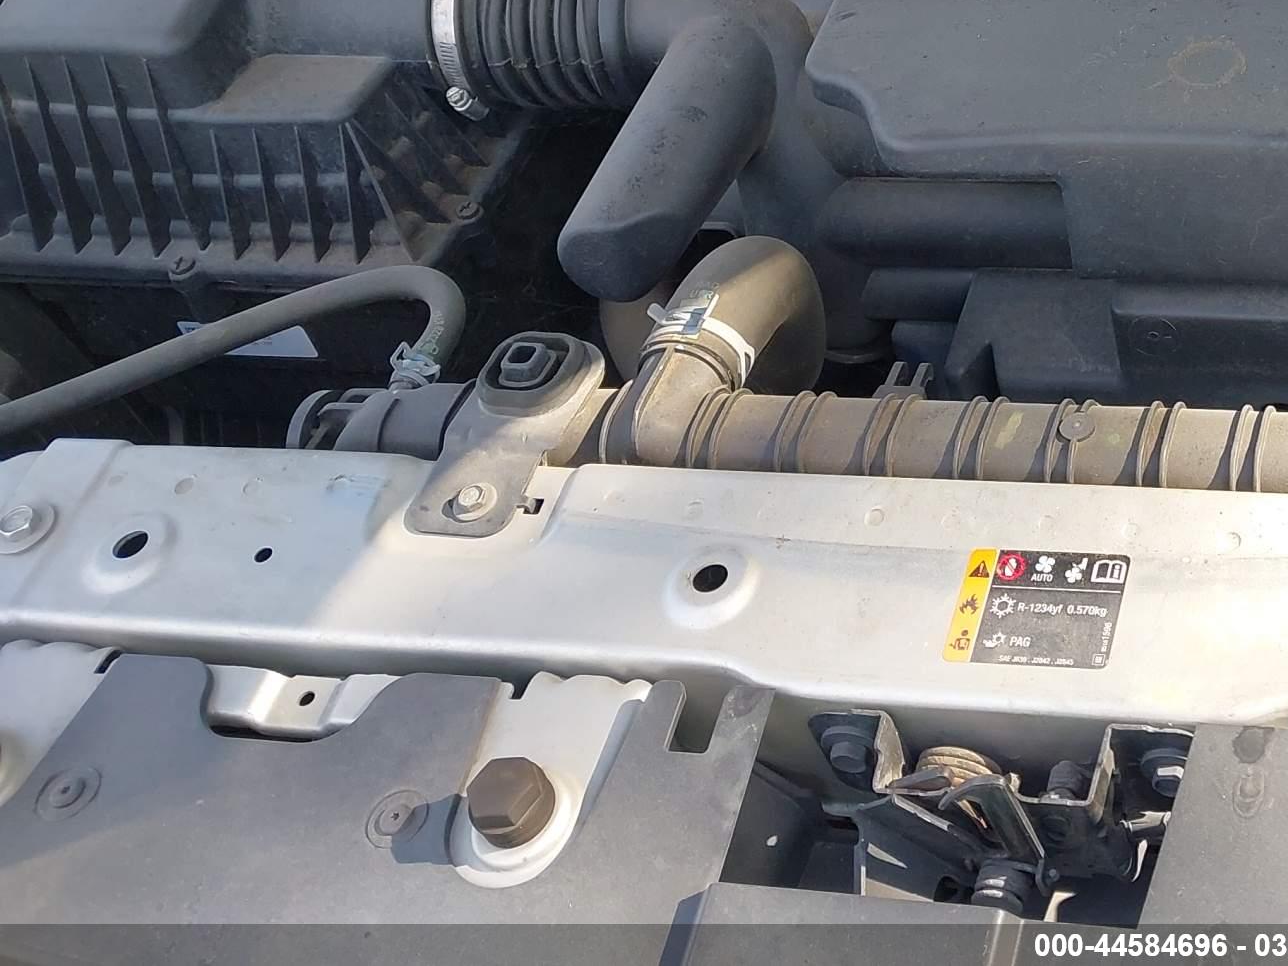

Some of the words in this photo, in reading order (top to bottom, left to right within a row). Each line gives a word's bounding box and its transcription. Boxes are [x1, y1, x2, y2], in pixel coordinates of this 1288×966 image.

[1031, 573, 1054, 582] AUTO
[1017, 602, 1063, 615] R-1234yf
[1066, 604, 1107, 617] 0.570kg
[1009, 636, 1031, 647] PAG
